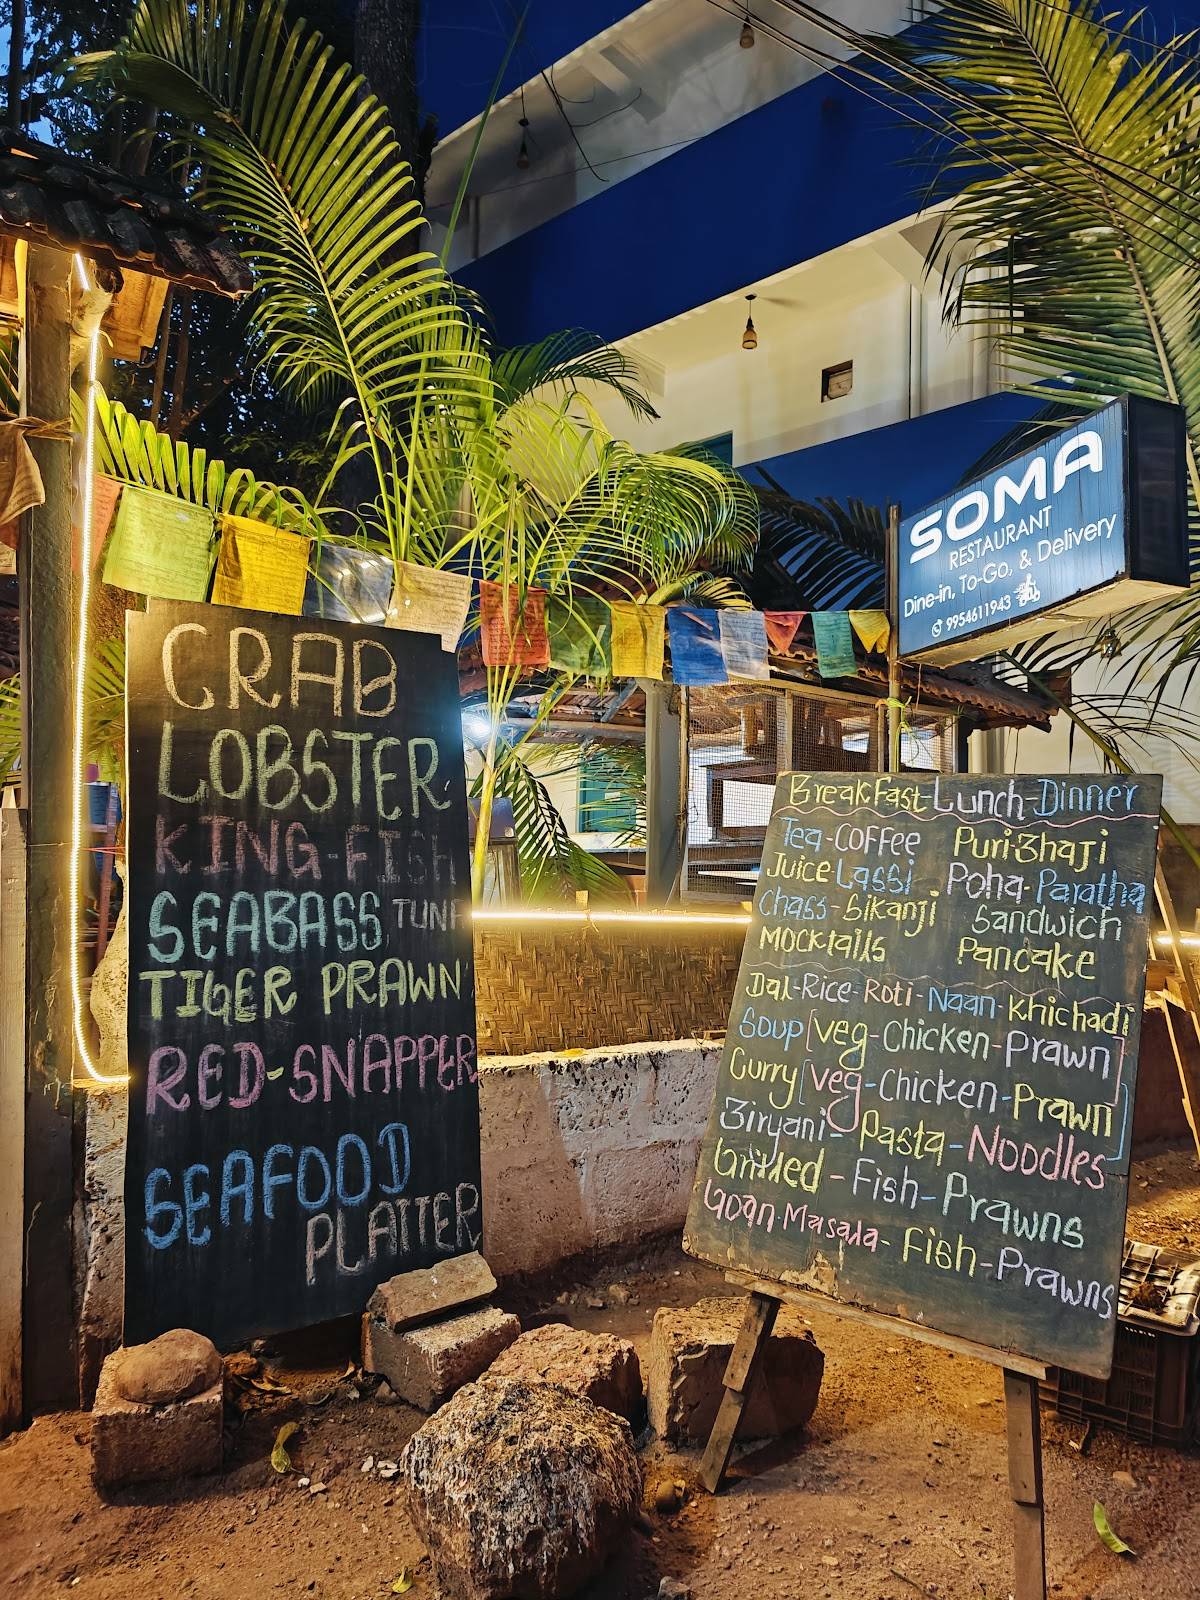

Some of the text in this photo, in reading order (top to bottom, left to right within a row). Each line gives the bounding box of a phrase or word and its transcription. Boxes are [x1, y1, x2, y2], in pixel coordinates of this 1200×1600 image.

[910, 430, 1103, 564] SOMA
[904, 583, 956, 618] Dine-in,
[1019, 550, 1033, 570] &
[1038, 514, 1117, 562] Delivery
[949, 505, 1053, 571] RESTAURANT
[946, 594, 1012, 632] 9954611943
[162, 623, 397, 718] CRAB
[159, 721, 451, 820] LOBSTER
[148, 890, 382, 963] SEABASS
[972, 904, 1122, 941] Sandwich
[957, 936, 1096, 980] Pancake
[139, 964, 297, 1025] TIGER
[739, 1006, 804, 1051] Soup
[730, 1047, 797, 1110] Curry
[143, 1122, 411, 1250] SEAFOOD
[307, 1182, 482, 1286] PLATTER
